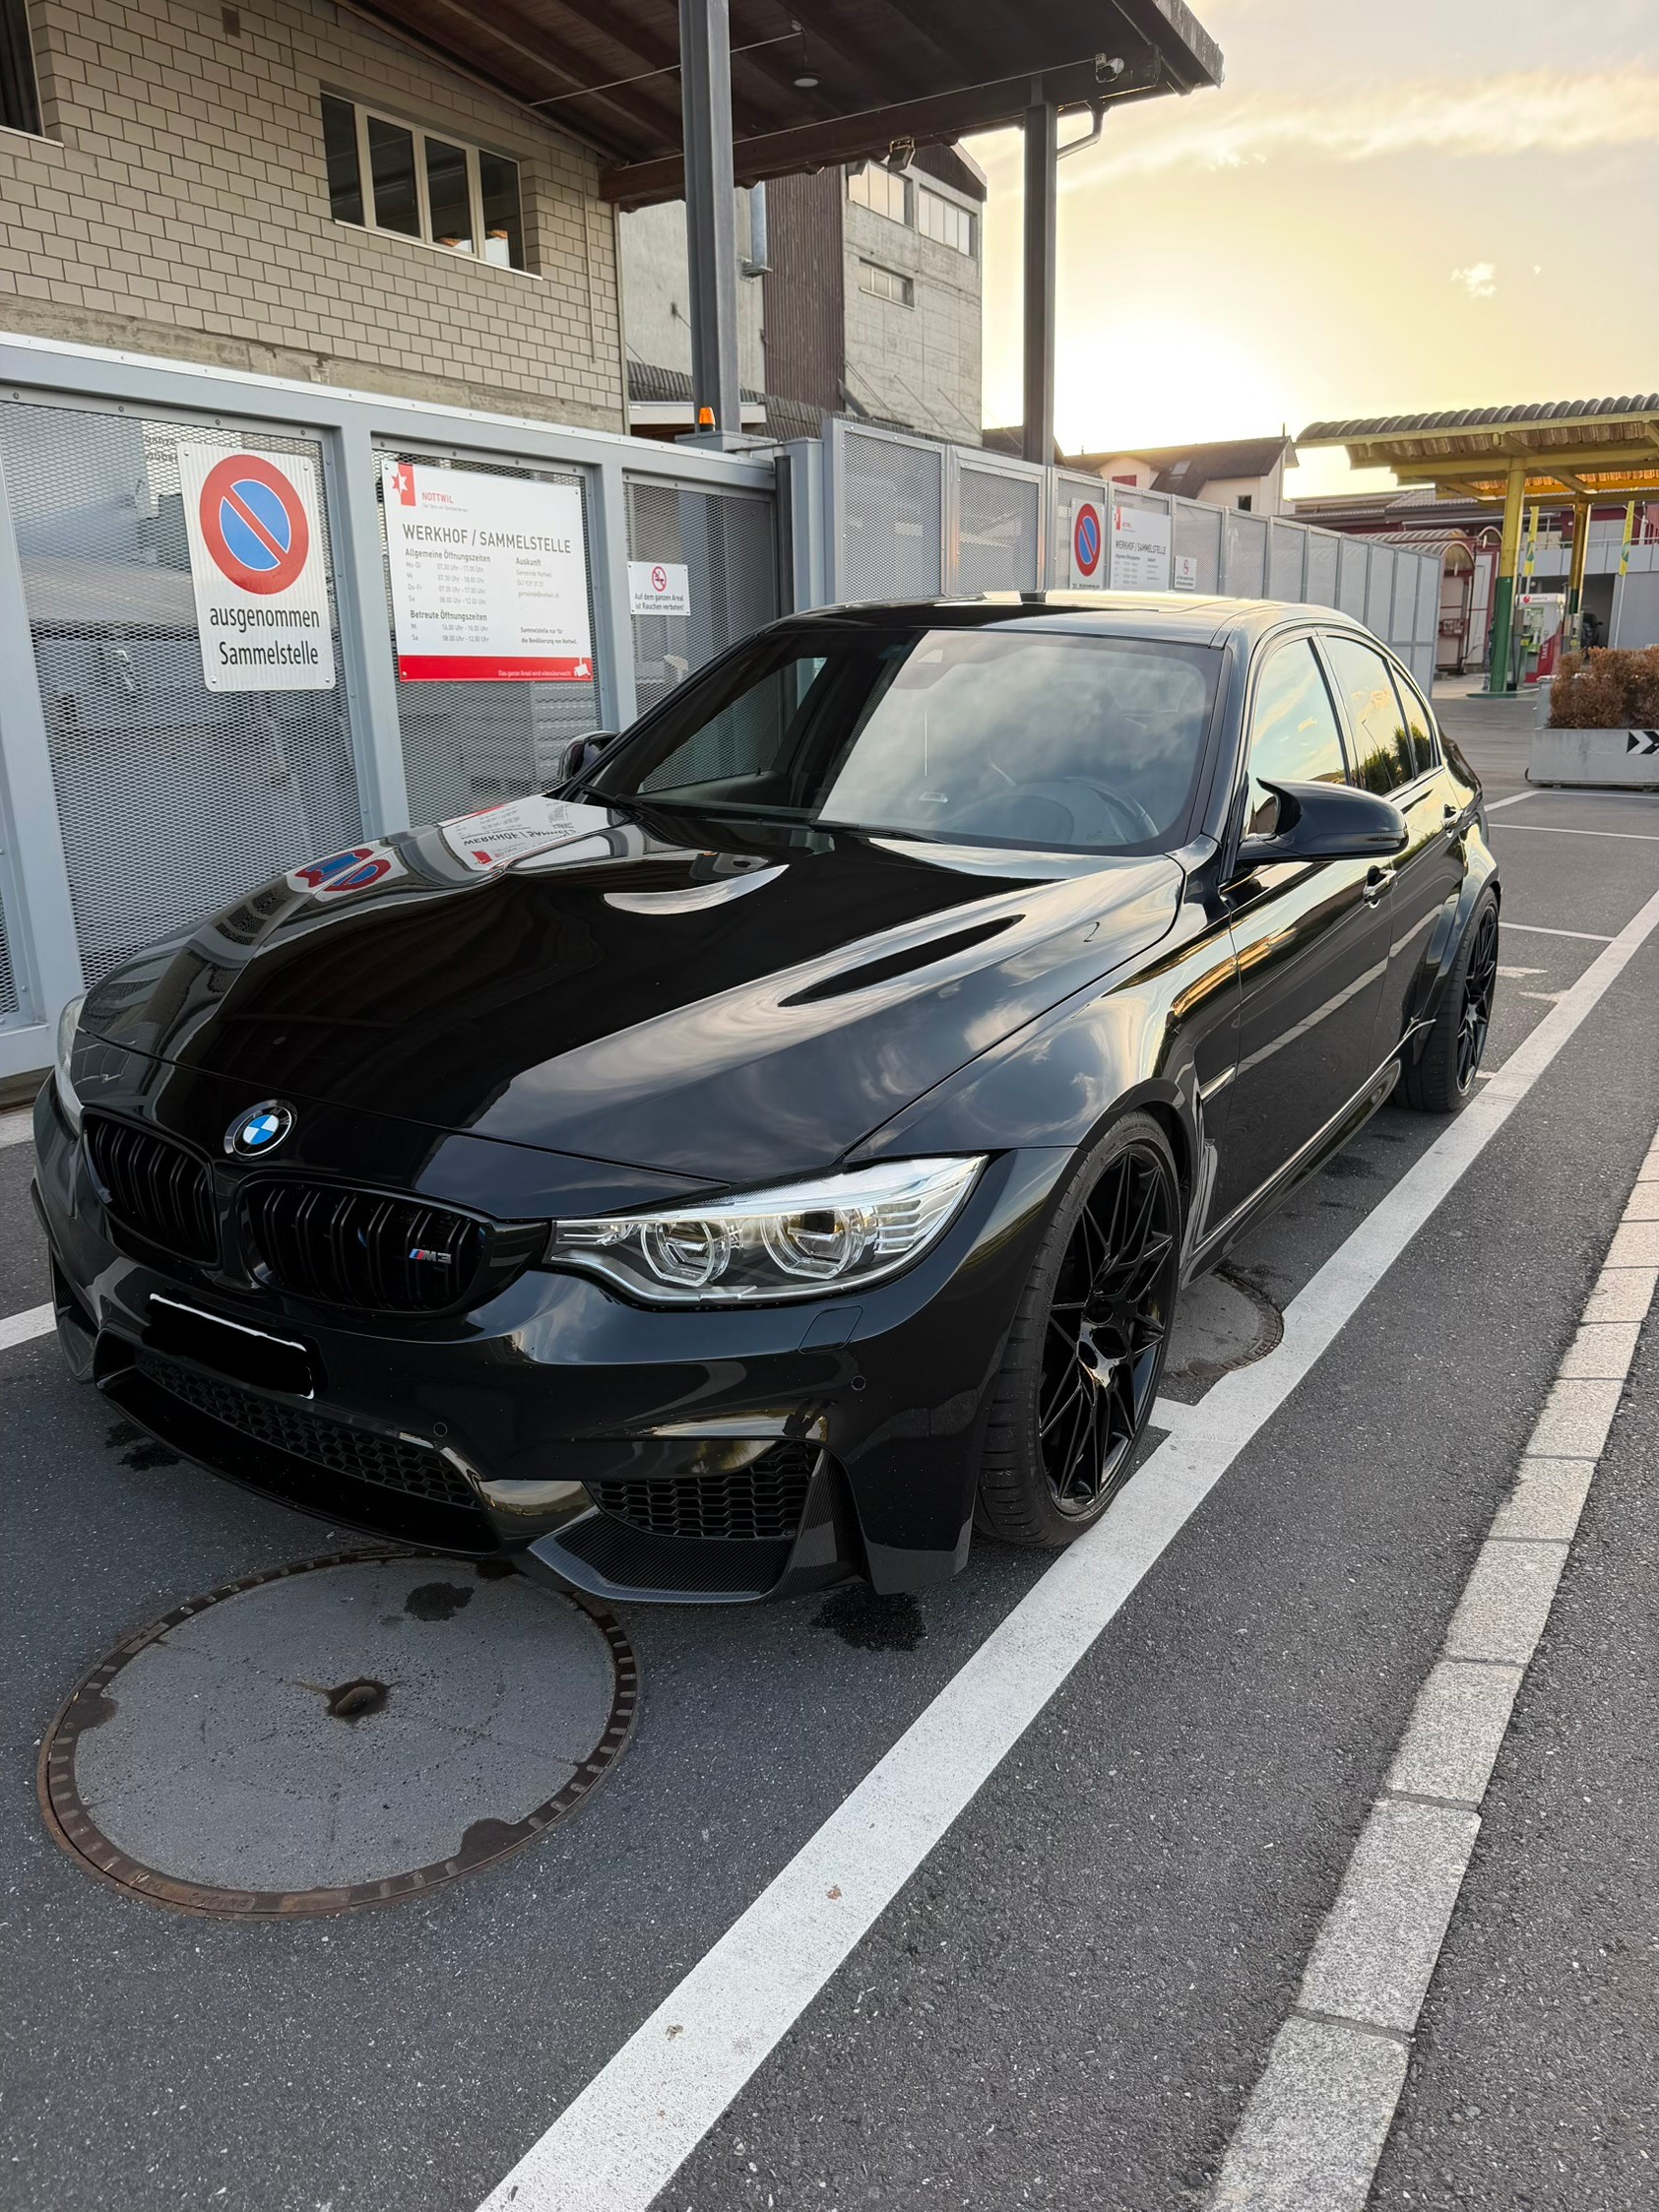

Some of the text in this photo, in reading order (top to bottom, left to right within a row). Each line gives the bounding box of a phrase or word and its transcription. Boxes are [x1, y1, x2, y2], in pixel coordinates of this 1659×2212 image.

[421, 492, 454, 504] NOTTWIL
[402, 524, 571, 553] WERKHOF / SAMMELSTELLE
[405, 547, 491, 563] Allgemeine Öffnungszeiten
[516, 557, 542, 566] Auskunft
[210, 607, 320, 633] ausgenommen
[410, 609, 488, 622] Betreute Öffnungszeiten
[219, 640, 319, 665] Sammelstelle
[422, 1250, 452, 1265] M3
